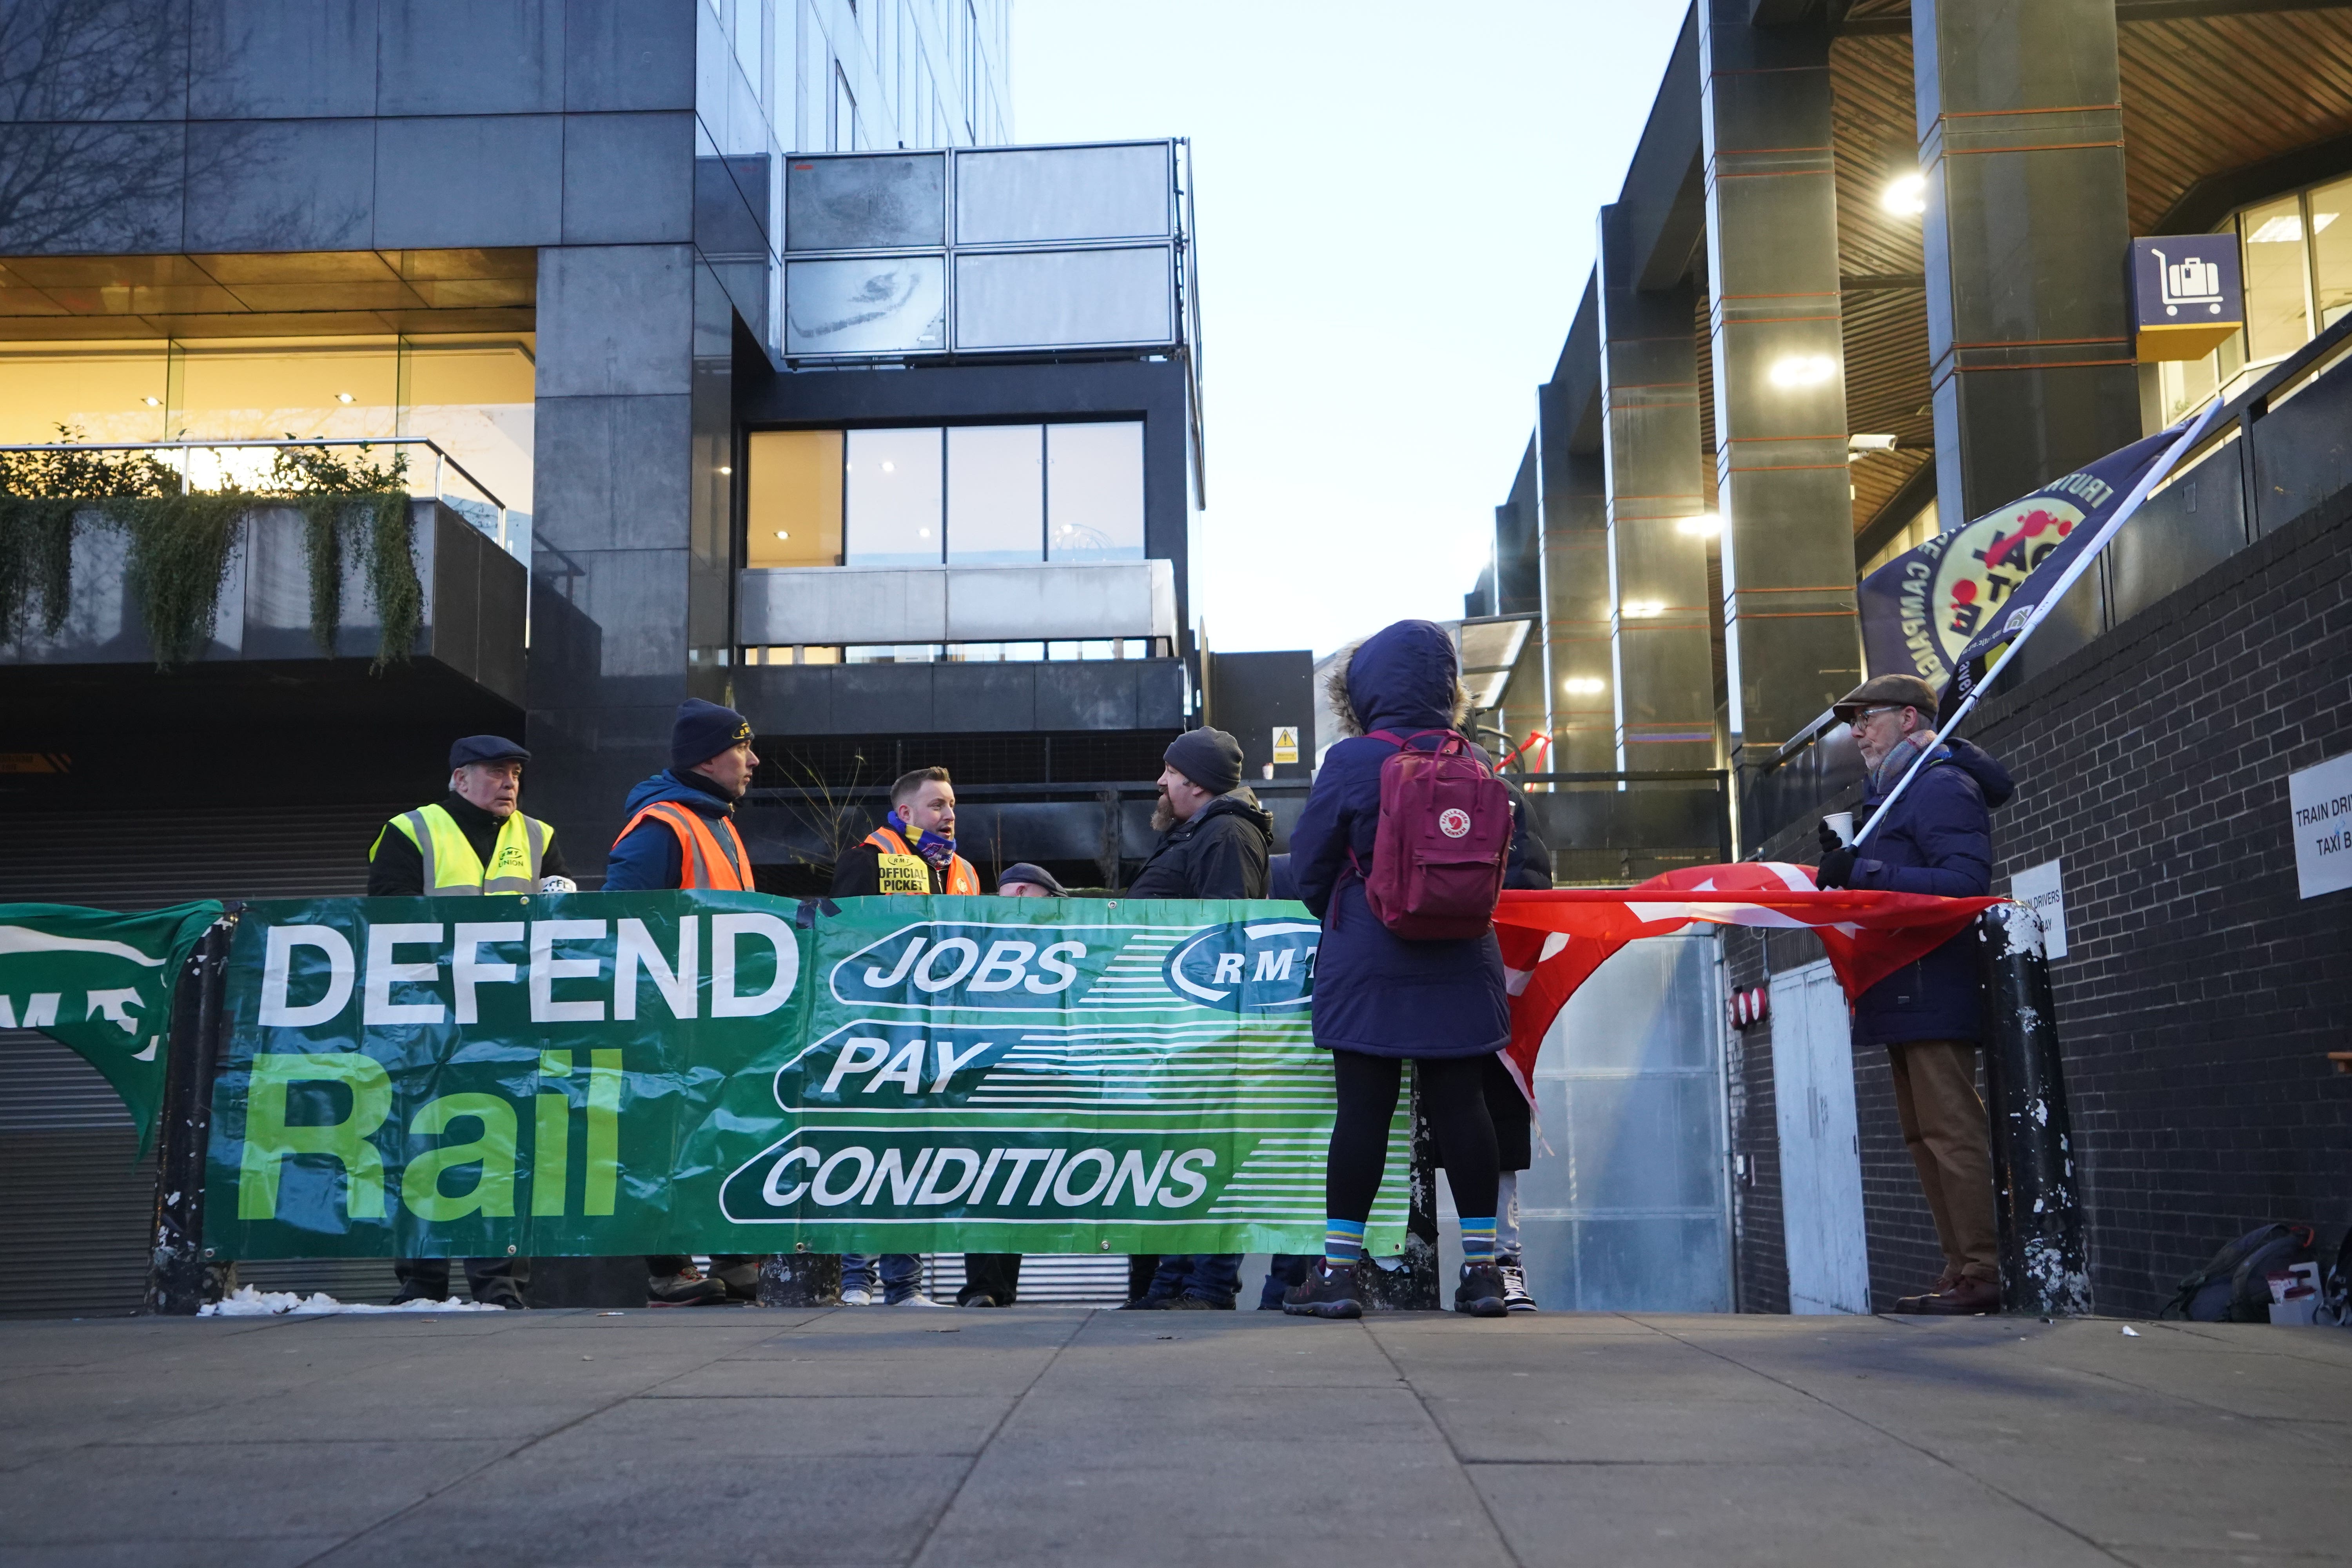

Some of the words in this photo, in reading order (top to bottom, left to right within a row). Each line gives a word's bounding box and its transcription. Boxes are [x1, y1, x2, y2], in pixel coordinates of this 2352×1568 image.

[2296, 802, 2328, 827] TRAIN
[2316, 834, 2341, 856] TAXI
[498, 859, 524, 867] UNION
[879, 867, 927, 879] OFFICIAL
[884, 879, 923, 891] PICKET
[2034, 889, 2060, 909] DRIVERS
[257, 913, 799, 1027] DEFEND
[862, 936, 1086, 995] JOBS
[821, 1037, 994, 1094] PAY
[238, 1048, 622, 1221] Rail
[762, 1147, 1216, 1208] CONDITIONS
